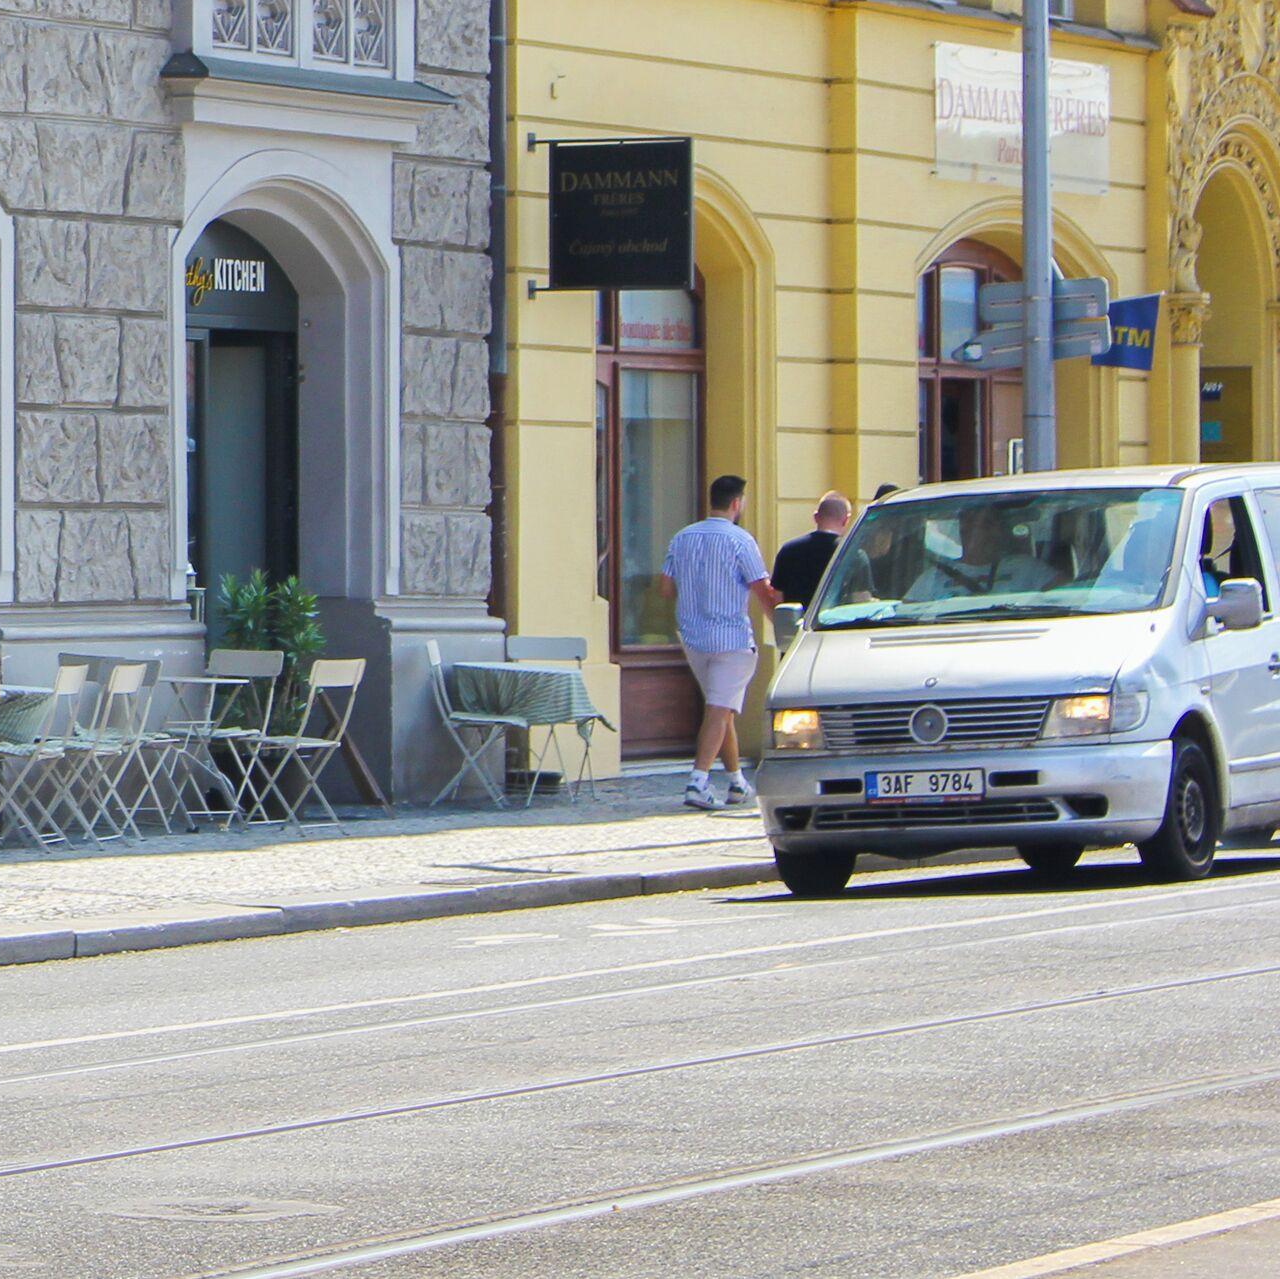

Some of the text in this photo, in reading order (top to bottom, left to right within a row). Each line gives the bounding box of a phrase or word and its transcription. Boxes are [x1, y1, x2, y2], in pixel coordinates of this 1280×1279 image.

[939, 77, 1023, 124] DAMMAN
[560, 169, 679, 192] DAMMANN
[214, 257, 265, 292] KITCHEN
[1114, 325, 1151, 349] TM
[881, 771, 973, 794] 3AF 9784
